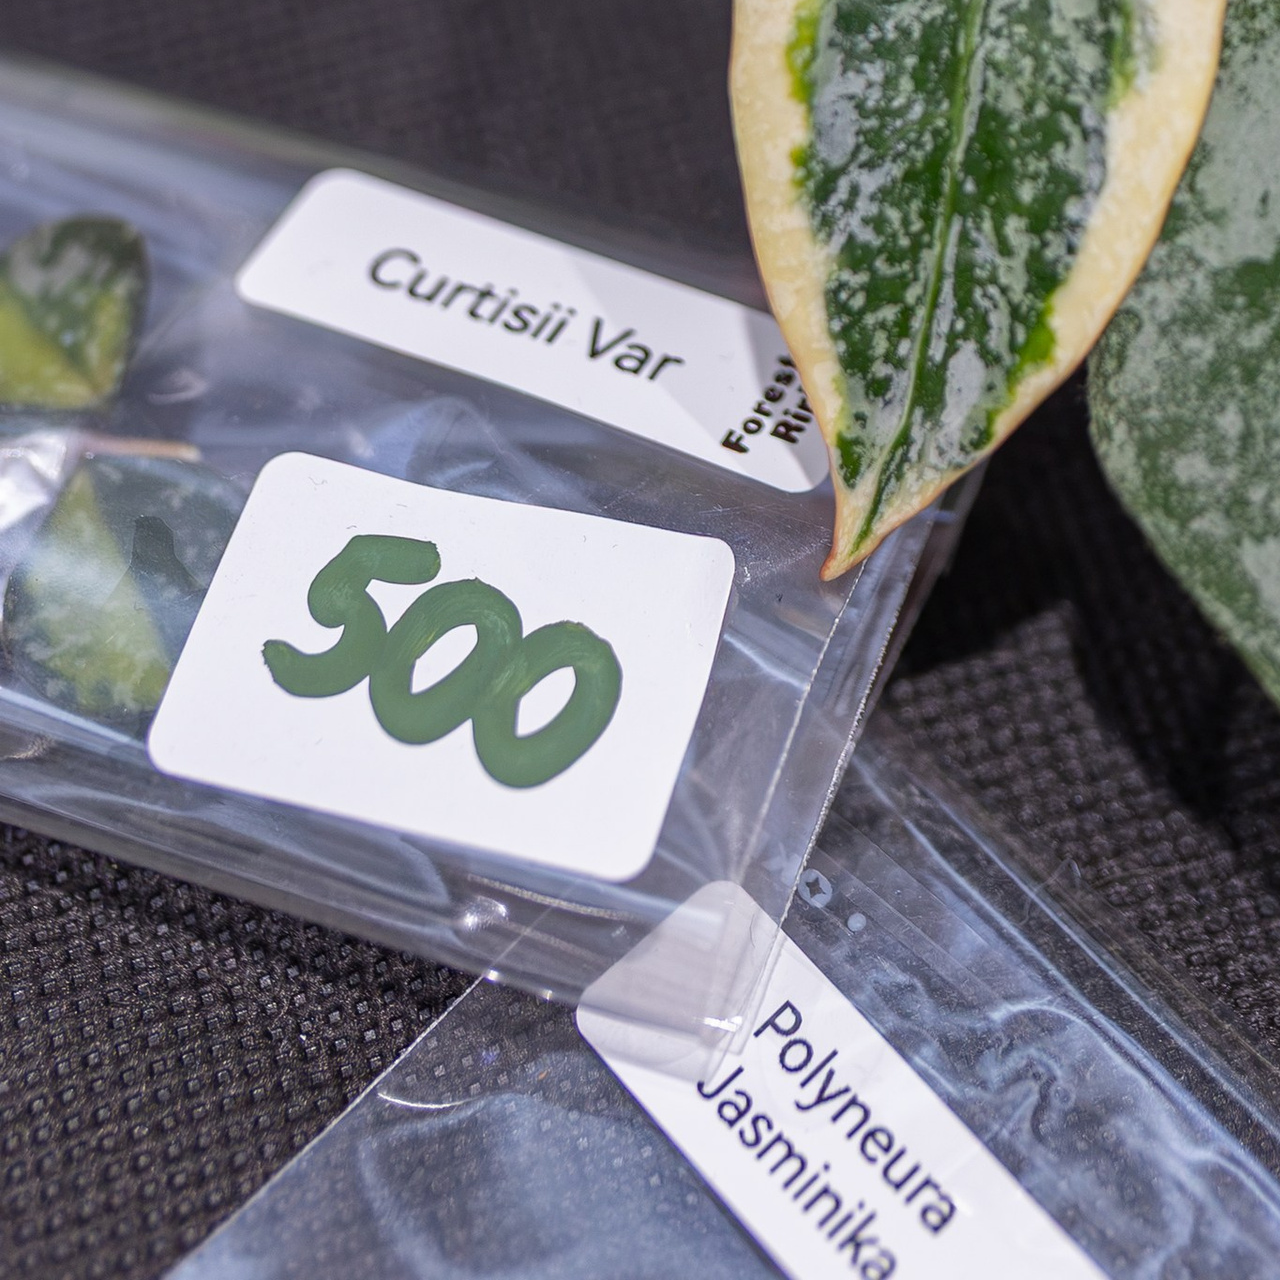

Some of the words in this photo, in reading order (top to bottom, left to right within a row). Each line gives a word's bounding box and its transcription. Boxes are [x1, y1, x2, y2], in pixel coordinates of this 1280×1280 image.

[367, 247, 576, 344] Curtisii
[587, 317, 686, 381] Var
[262, 534, 623, 789] 500
[697, 1066, 897, 1280] Jasminika
[753, 1000, 957, 1233] Polyneura
